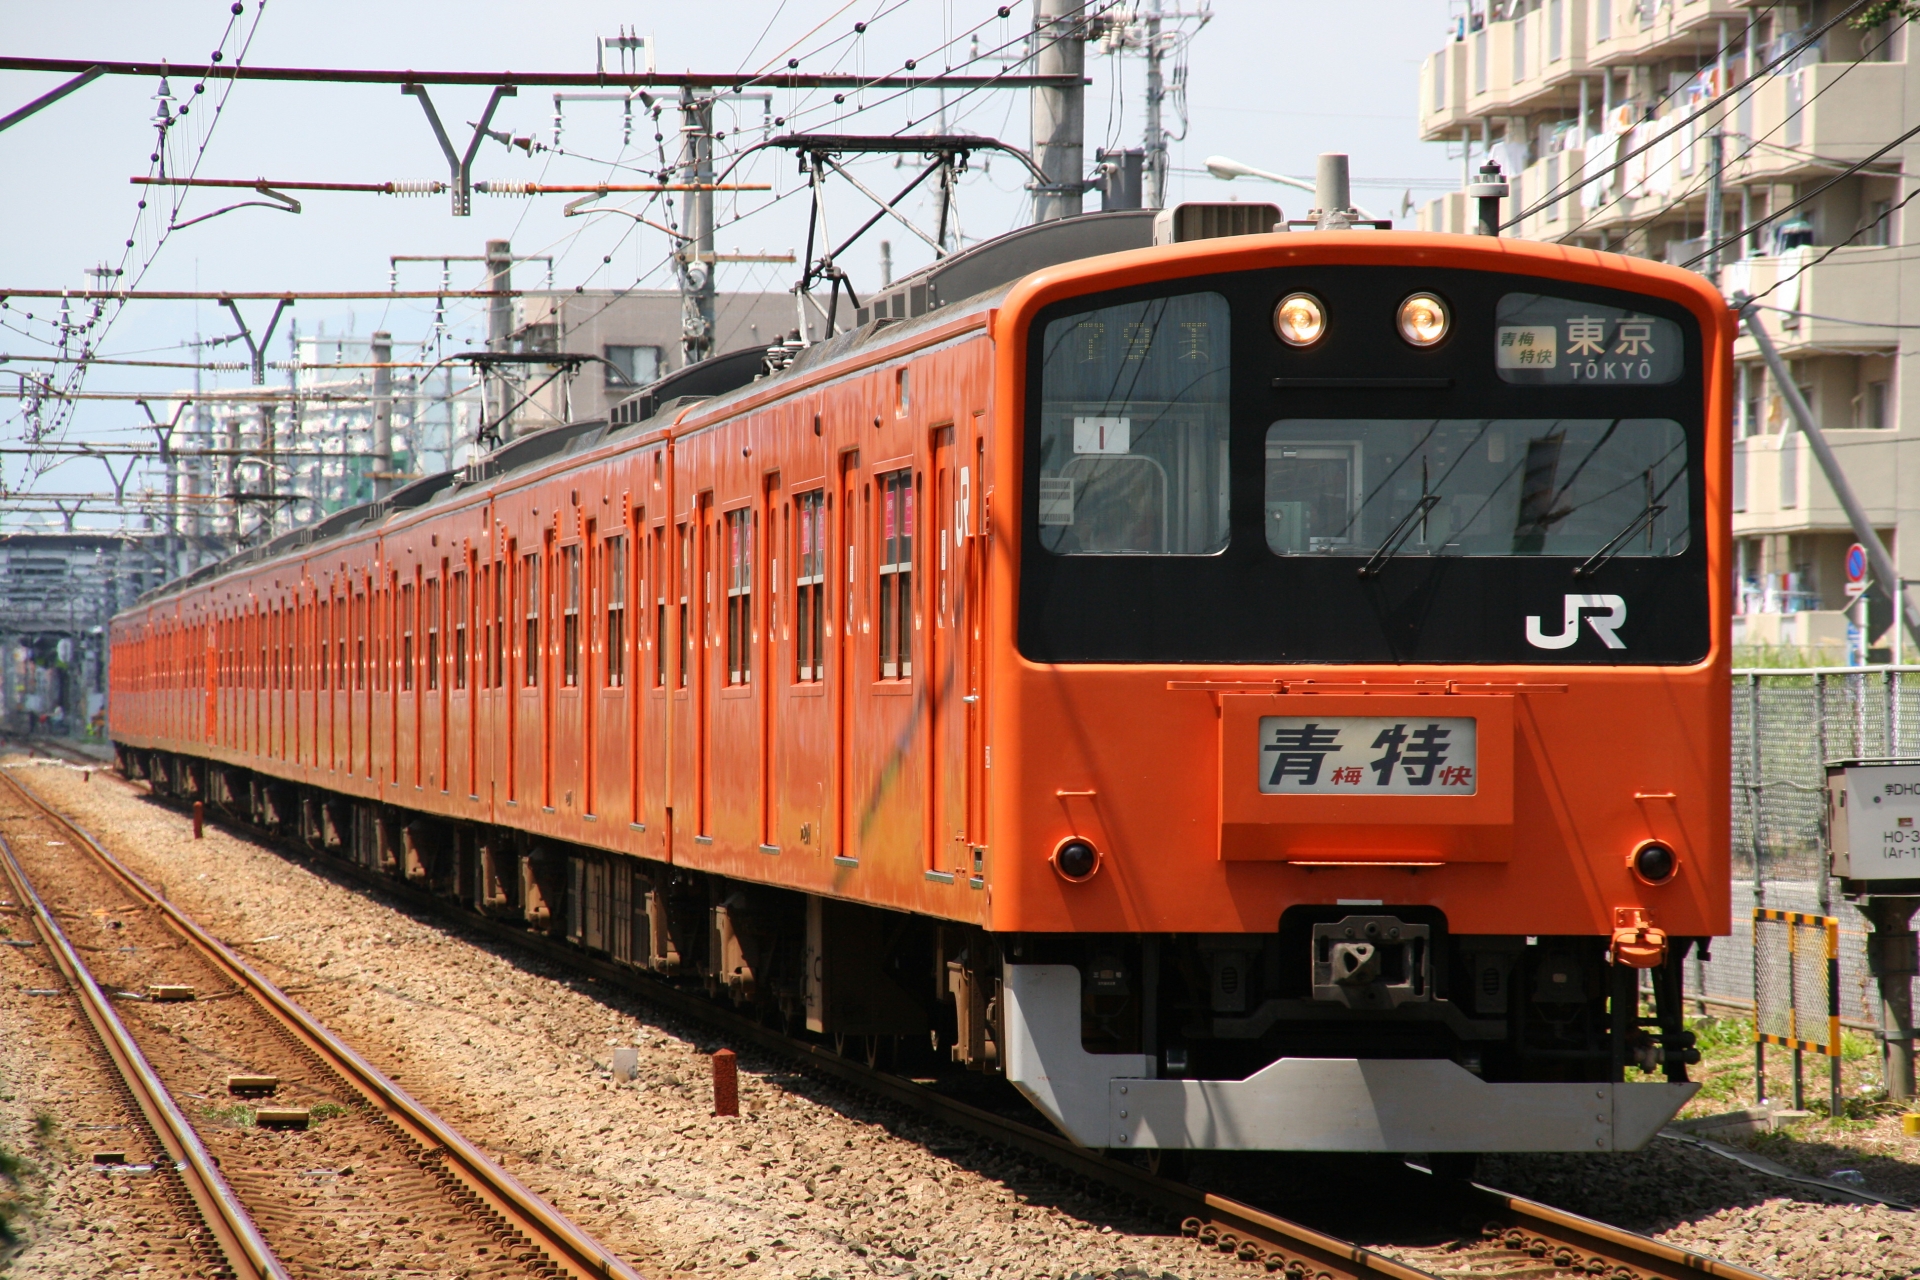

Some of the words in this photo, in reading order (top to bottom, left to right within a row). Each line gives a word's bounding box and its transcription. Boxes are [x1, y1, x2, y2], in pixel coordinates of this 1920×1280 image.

[1501, 331, 1535, 347] 青梅
[1566, 315, 1655, 356] 東京
[1519, 349, 1553, 364] 特快
[955, 466, 969, 547] JR
[1526, 594, 1627, 649] JR
